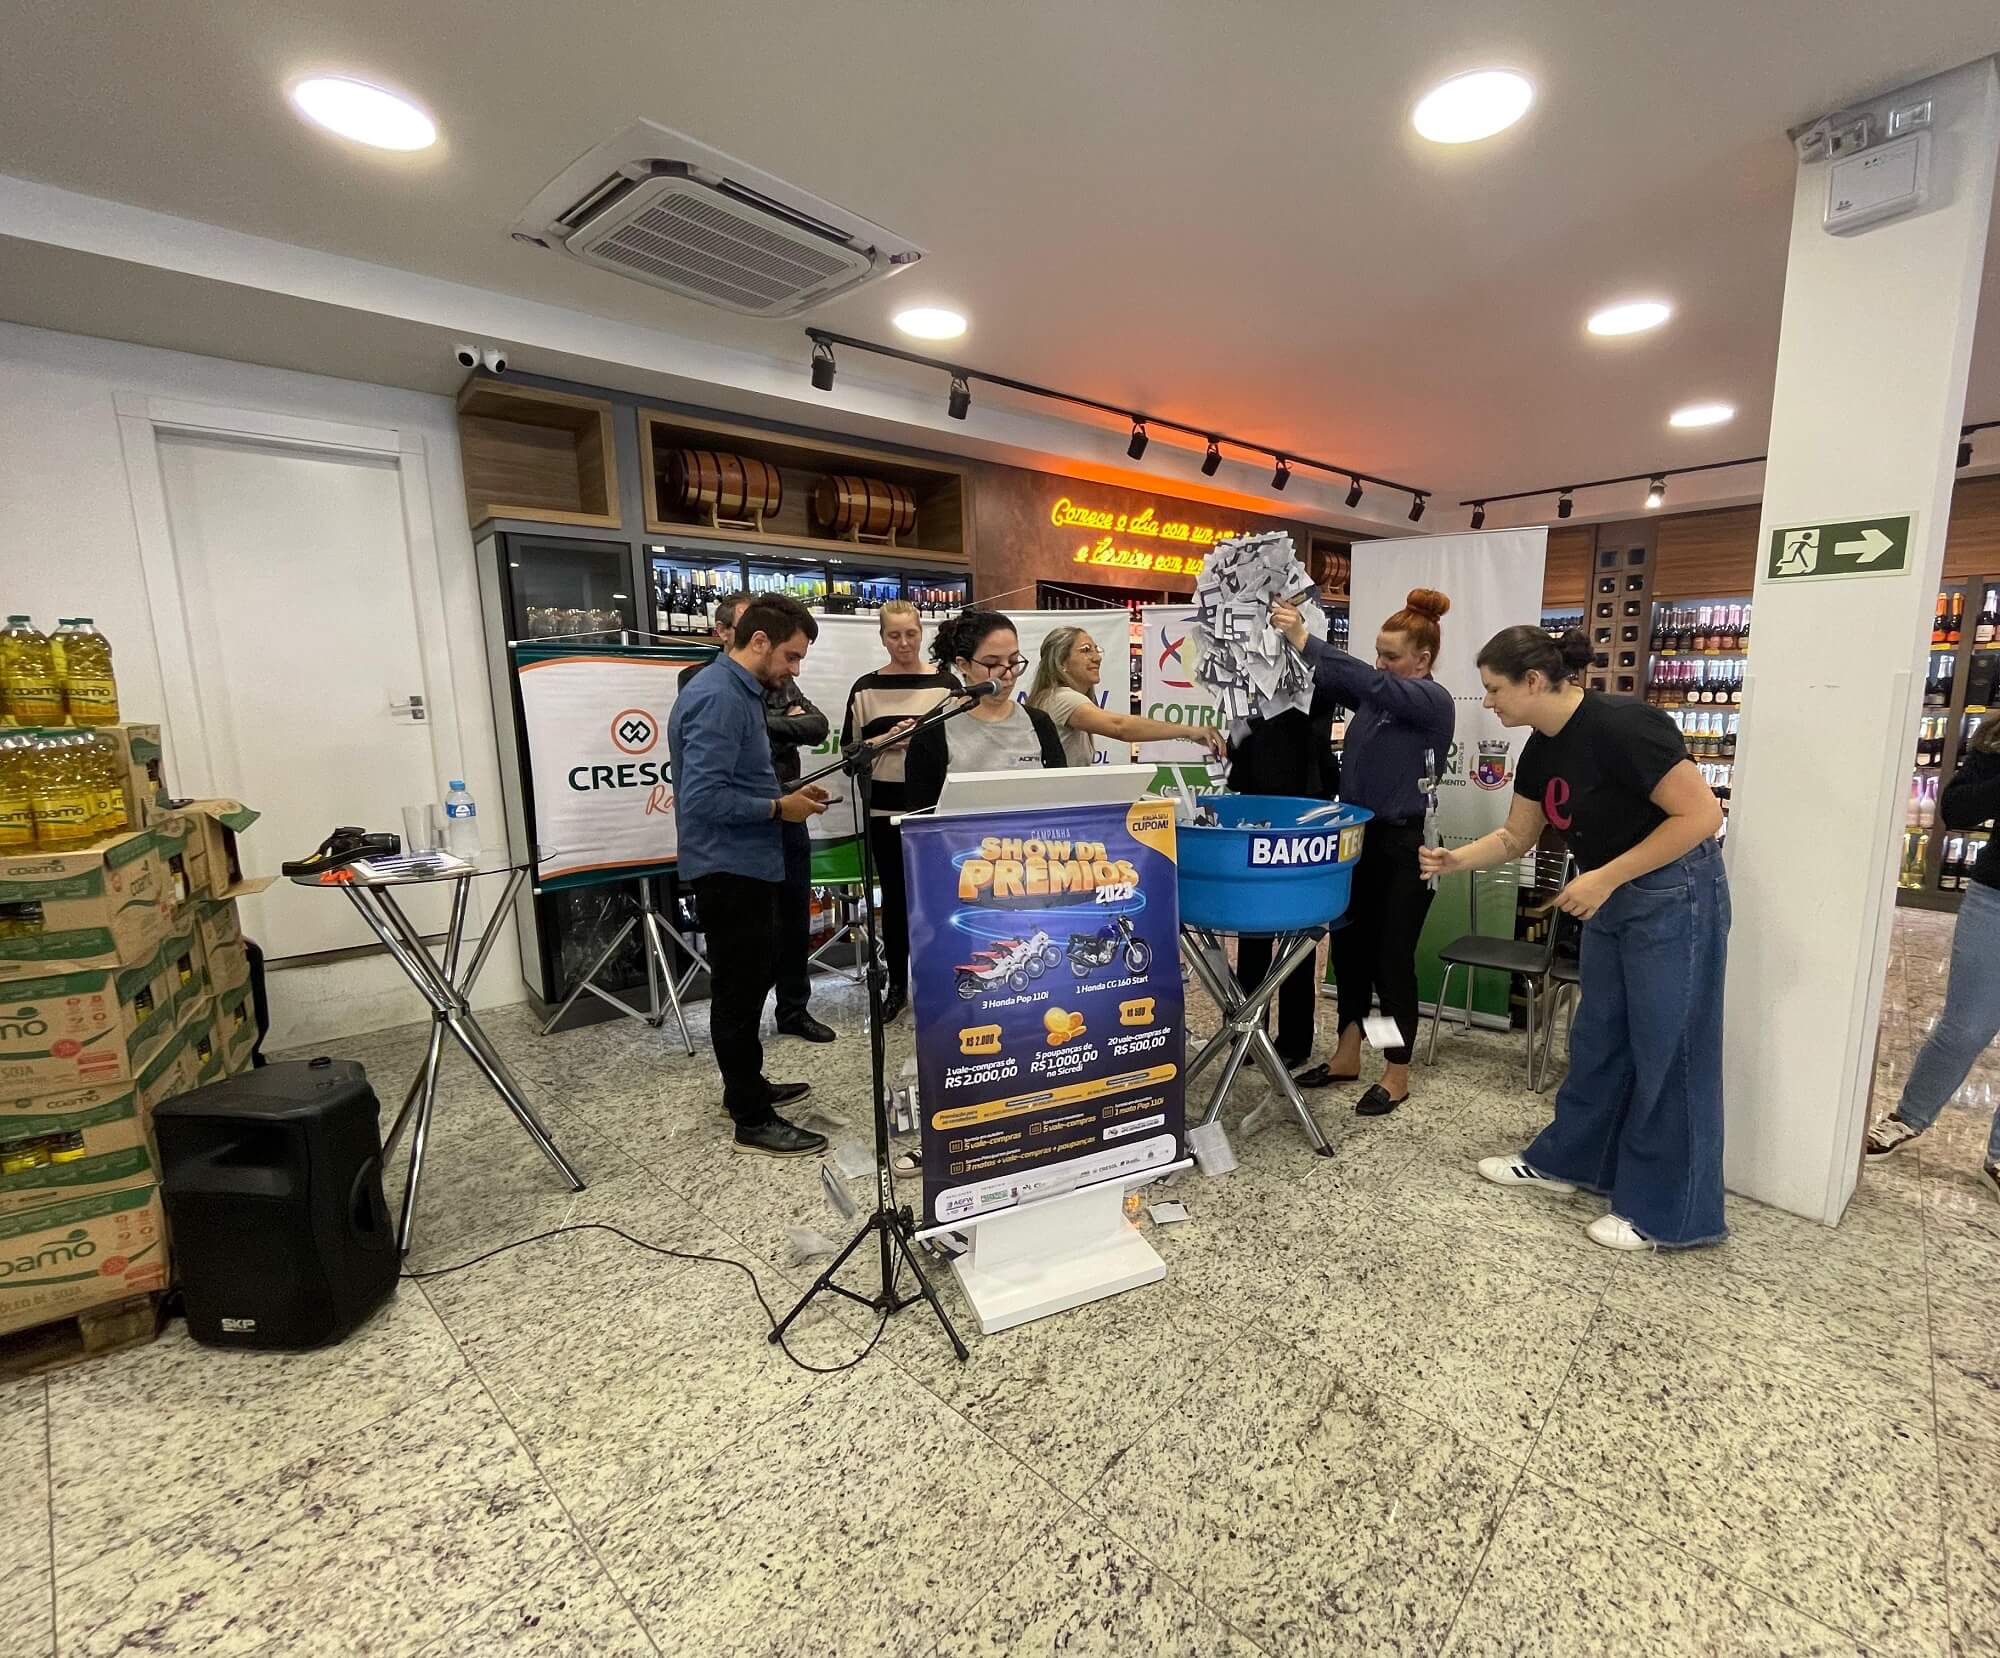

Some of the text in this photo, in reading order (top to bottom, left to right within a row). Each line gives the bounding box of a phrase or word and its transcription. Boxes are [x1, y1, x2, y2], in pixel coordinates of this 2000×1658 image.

[1052, 498, 1113, 529] Comece
[1116, 515, 1127, 529] o
[1130, 508, 1158, 533] dia
[1162, 522, 1189, 538] com
[1076, 545, 1089, 560] e
[1155, 555, 1182, 571] com
[1545, 777, 1573, 830] e
[1031, 828, 1071, 841] CAMPANHA
[1132, 820, 1168, 831] CUPOM!
[980, 837, 1108, 861] SHOW DE
[1252, 835, 1338, 864] BAKOF
[8, 865, 65, 876] coamo
[1095, 883, 1134, 905] 2023
[1076, 975, 1149, 994] 1 Honda CG 160 Start
[982, 990, 1050, 1009] 3 Honda Pop 110i
[975, 1033, 994, 1046] 2.000
[1107, 1026, 1172, 1046] 20 vale-compras de
[1129, 1036, 1166, 1052] 500,00
[1035, 1042, 1093, 1060] 5 poupanças de
[1047, 1050, 1098, 1070] 1.000,00
[946, 1057, 1016, 1076] 1 vale-compras de
[962, 1065, 1018, 1086] 2.000,00
[1057, 1063, 1083, 1076] Sicredi
[1043, 1123, 1049, 1133] 5
[1049, 1114, 1096, 1131] vale-compras
[963, 1142, 970, 1151] 5
[970, 1132, 1022, 1149] vale-compras
[965, 1163, 971, 1172] 3
[972, 1159, 996, 1171] motos
[1002, 1146, 1052, 1164] vale-compras
[221, 1318, 255, 1329] SKP
